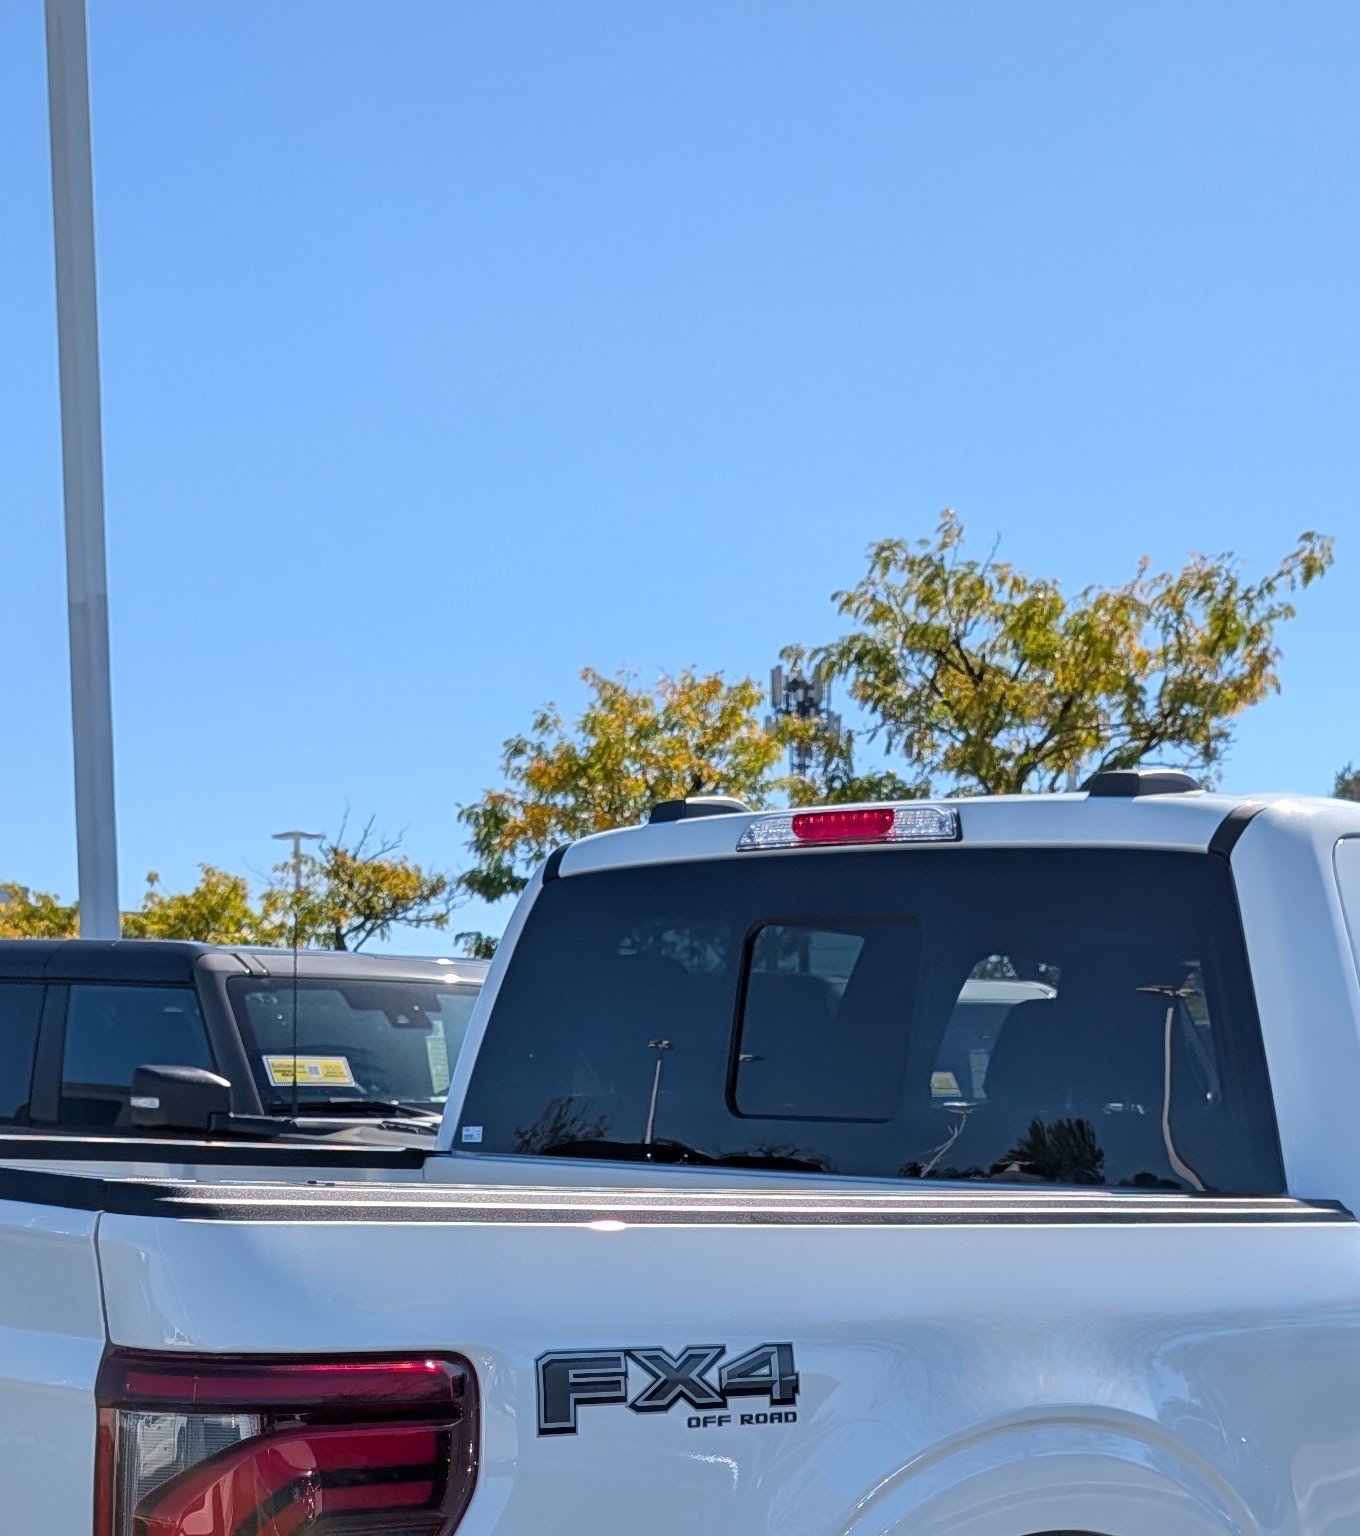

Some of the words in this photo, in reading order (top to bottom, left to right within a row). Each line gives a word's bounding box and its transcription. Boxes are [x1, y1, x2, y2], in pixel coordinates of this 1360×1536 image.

[533, 1341, 800, 1438] FX4
[687, 1415, 732, 1428] OFF
[740, 1411, 797, 1426] ROAD
